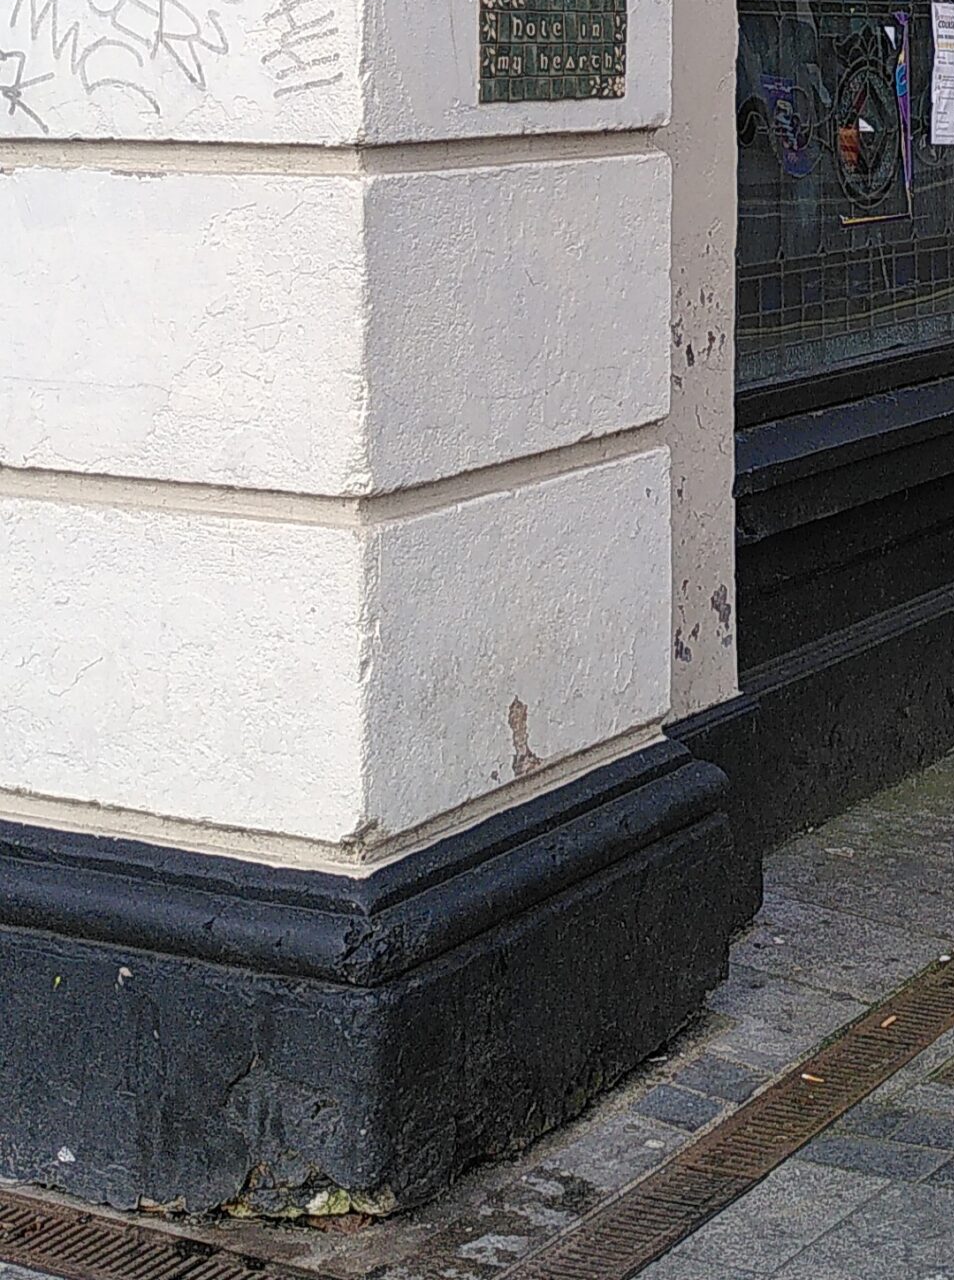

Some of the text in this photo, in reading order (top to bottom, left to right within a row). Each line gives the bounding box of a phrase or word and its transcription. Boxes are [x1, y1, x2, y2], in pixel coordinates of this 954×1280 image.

[513, 16, 600, 37] hole in
[497, 52, 613, 75] my hearth
